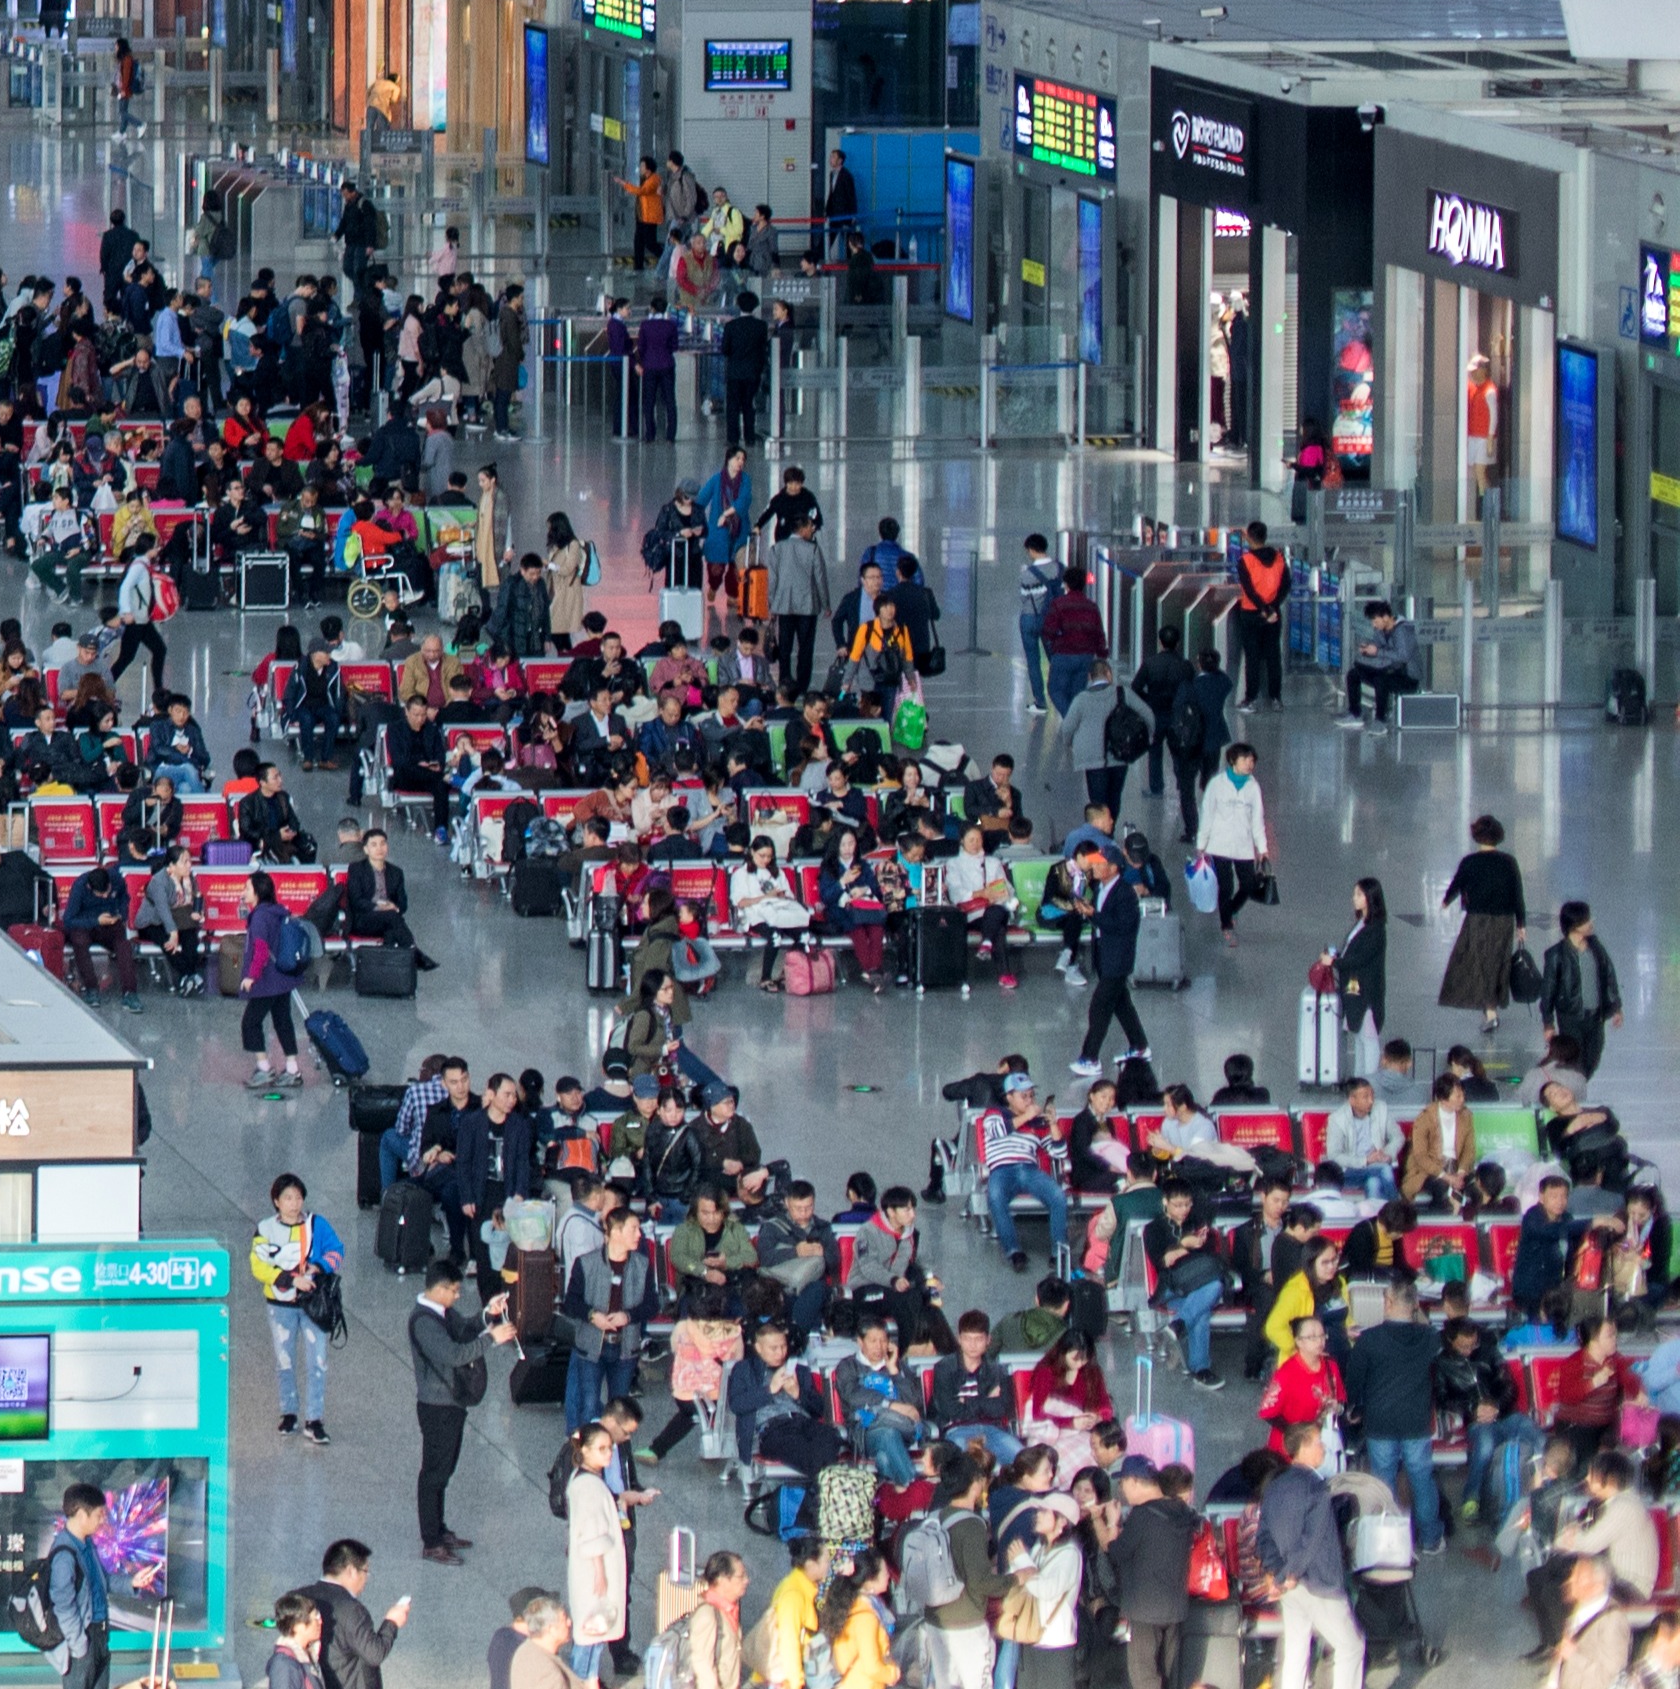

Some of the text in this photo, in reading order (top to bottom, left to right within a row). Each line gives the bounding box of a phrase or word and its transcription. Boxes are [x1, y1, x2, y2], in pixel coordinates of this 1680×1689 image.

[1191, 114, 1244, 154] NORTHLAND
[1429, 192, 1505, 272] HONMA
[129, 1262, 168, 1285] 4-30
